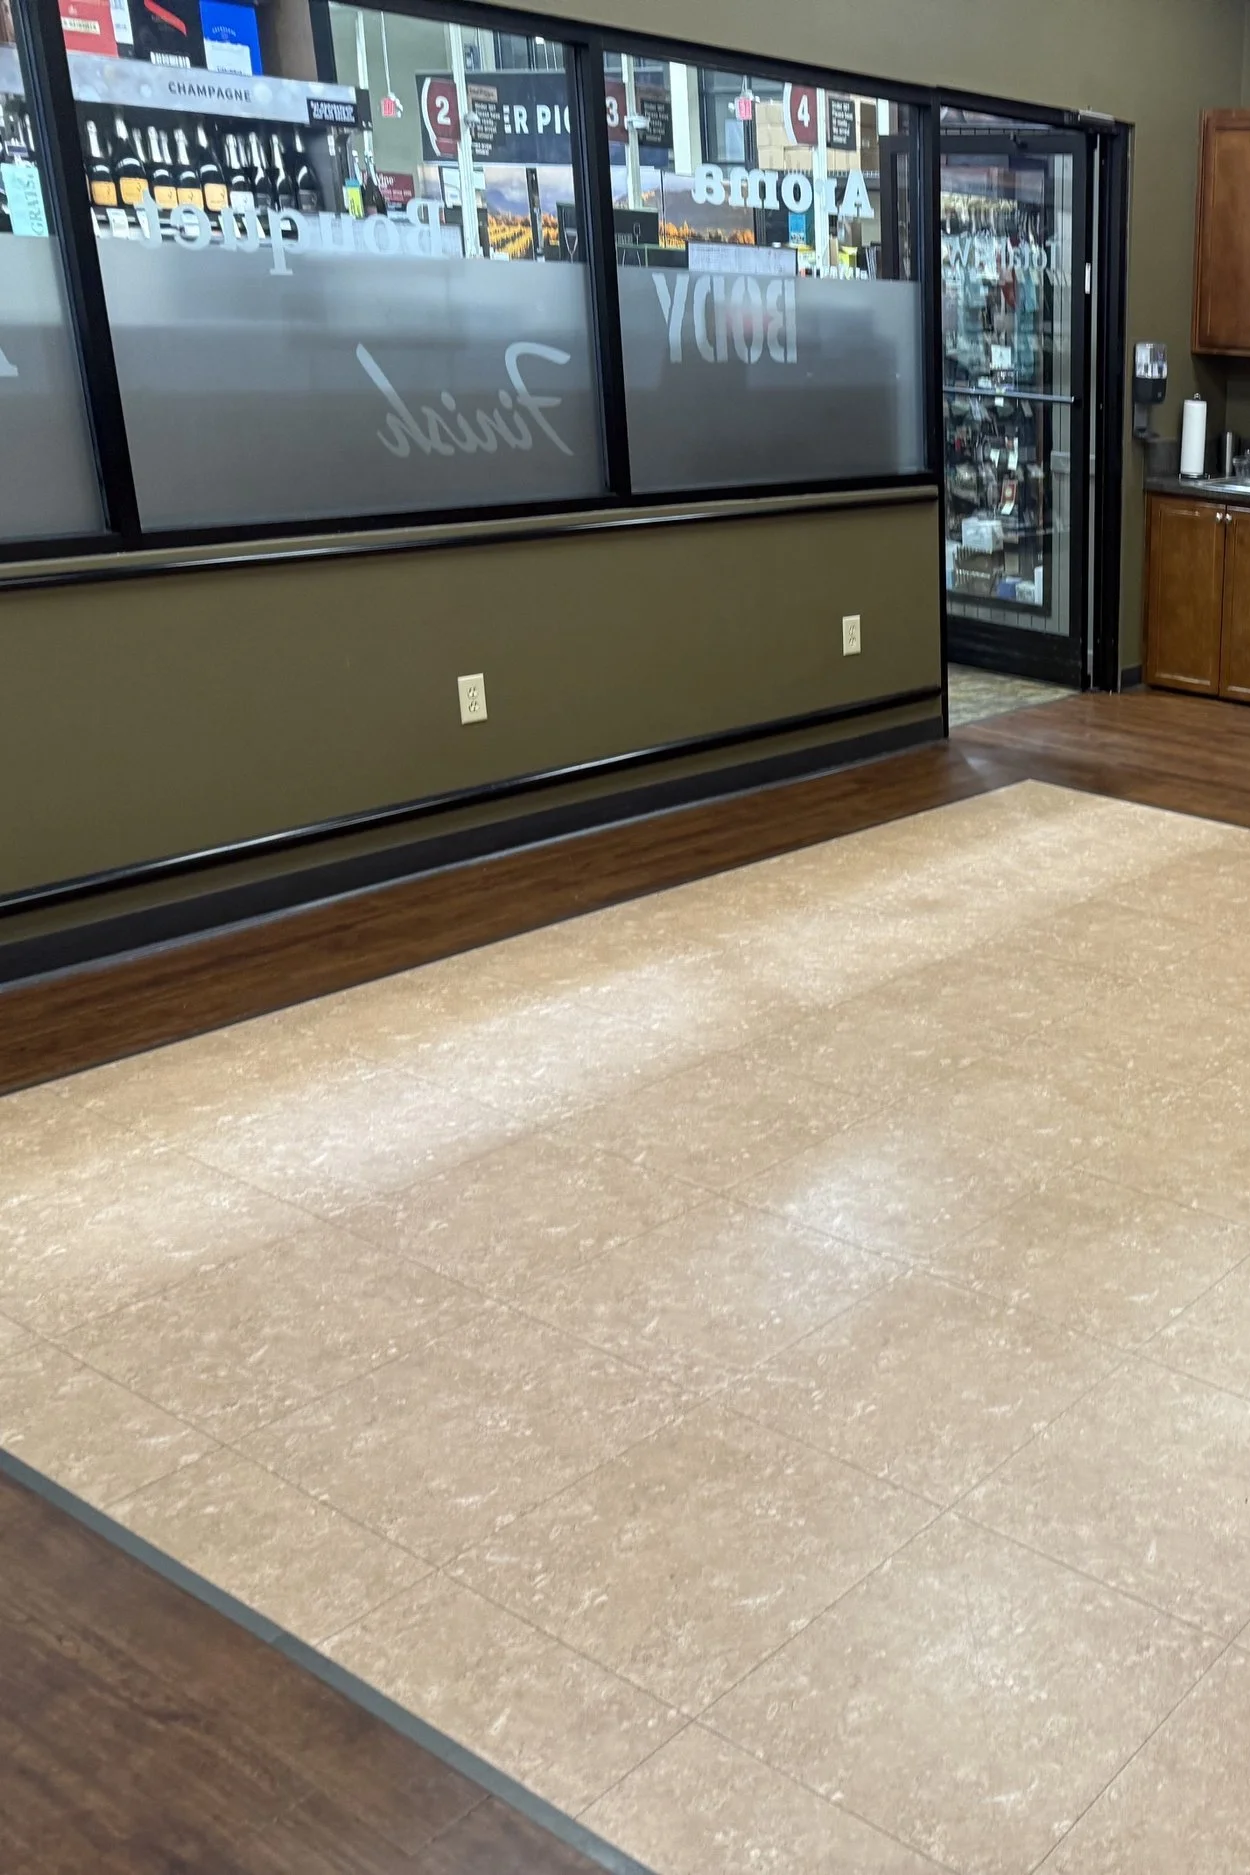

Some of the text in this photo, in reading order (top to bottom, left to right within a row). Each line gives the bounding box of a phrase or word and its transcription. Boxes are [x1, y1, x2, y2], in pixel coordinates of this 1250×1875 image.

[168, 80, 252, 103] CHAMPAGNE
[435, 95, 452, 126] 2
[536, 103, 571, 135] PI
[605, 96, 620, 127] 3
[797, 94, 811, 128] 4
